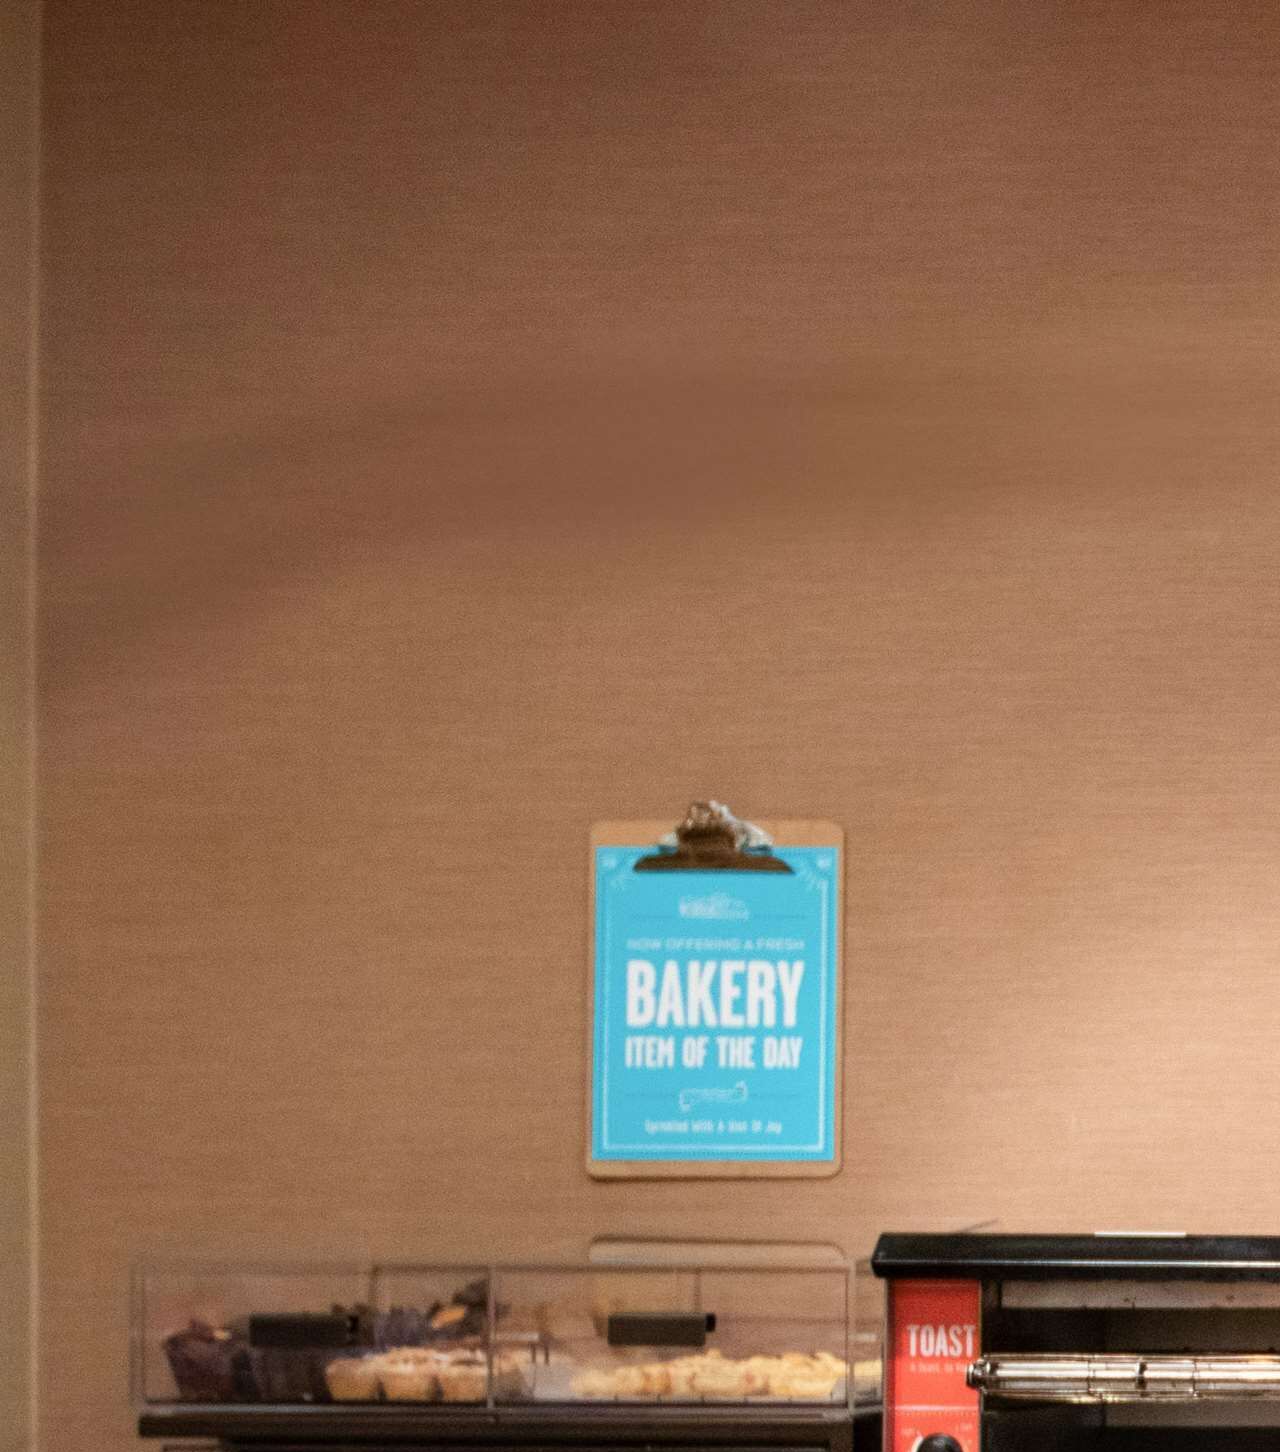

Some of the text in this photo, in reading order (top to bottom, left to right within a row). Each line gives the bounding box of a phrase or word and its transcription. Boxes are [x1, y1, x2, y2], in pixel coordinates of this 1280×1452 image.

[626, 959, 806, 1028] BAKERY
[624, 1036, 803, 1068] ITEM OF THE DAY
[907, 1324, 977, 1357] TOAST
